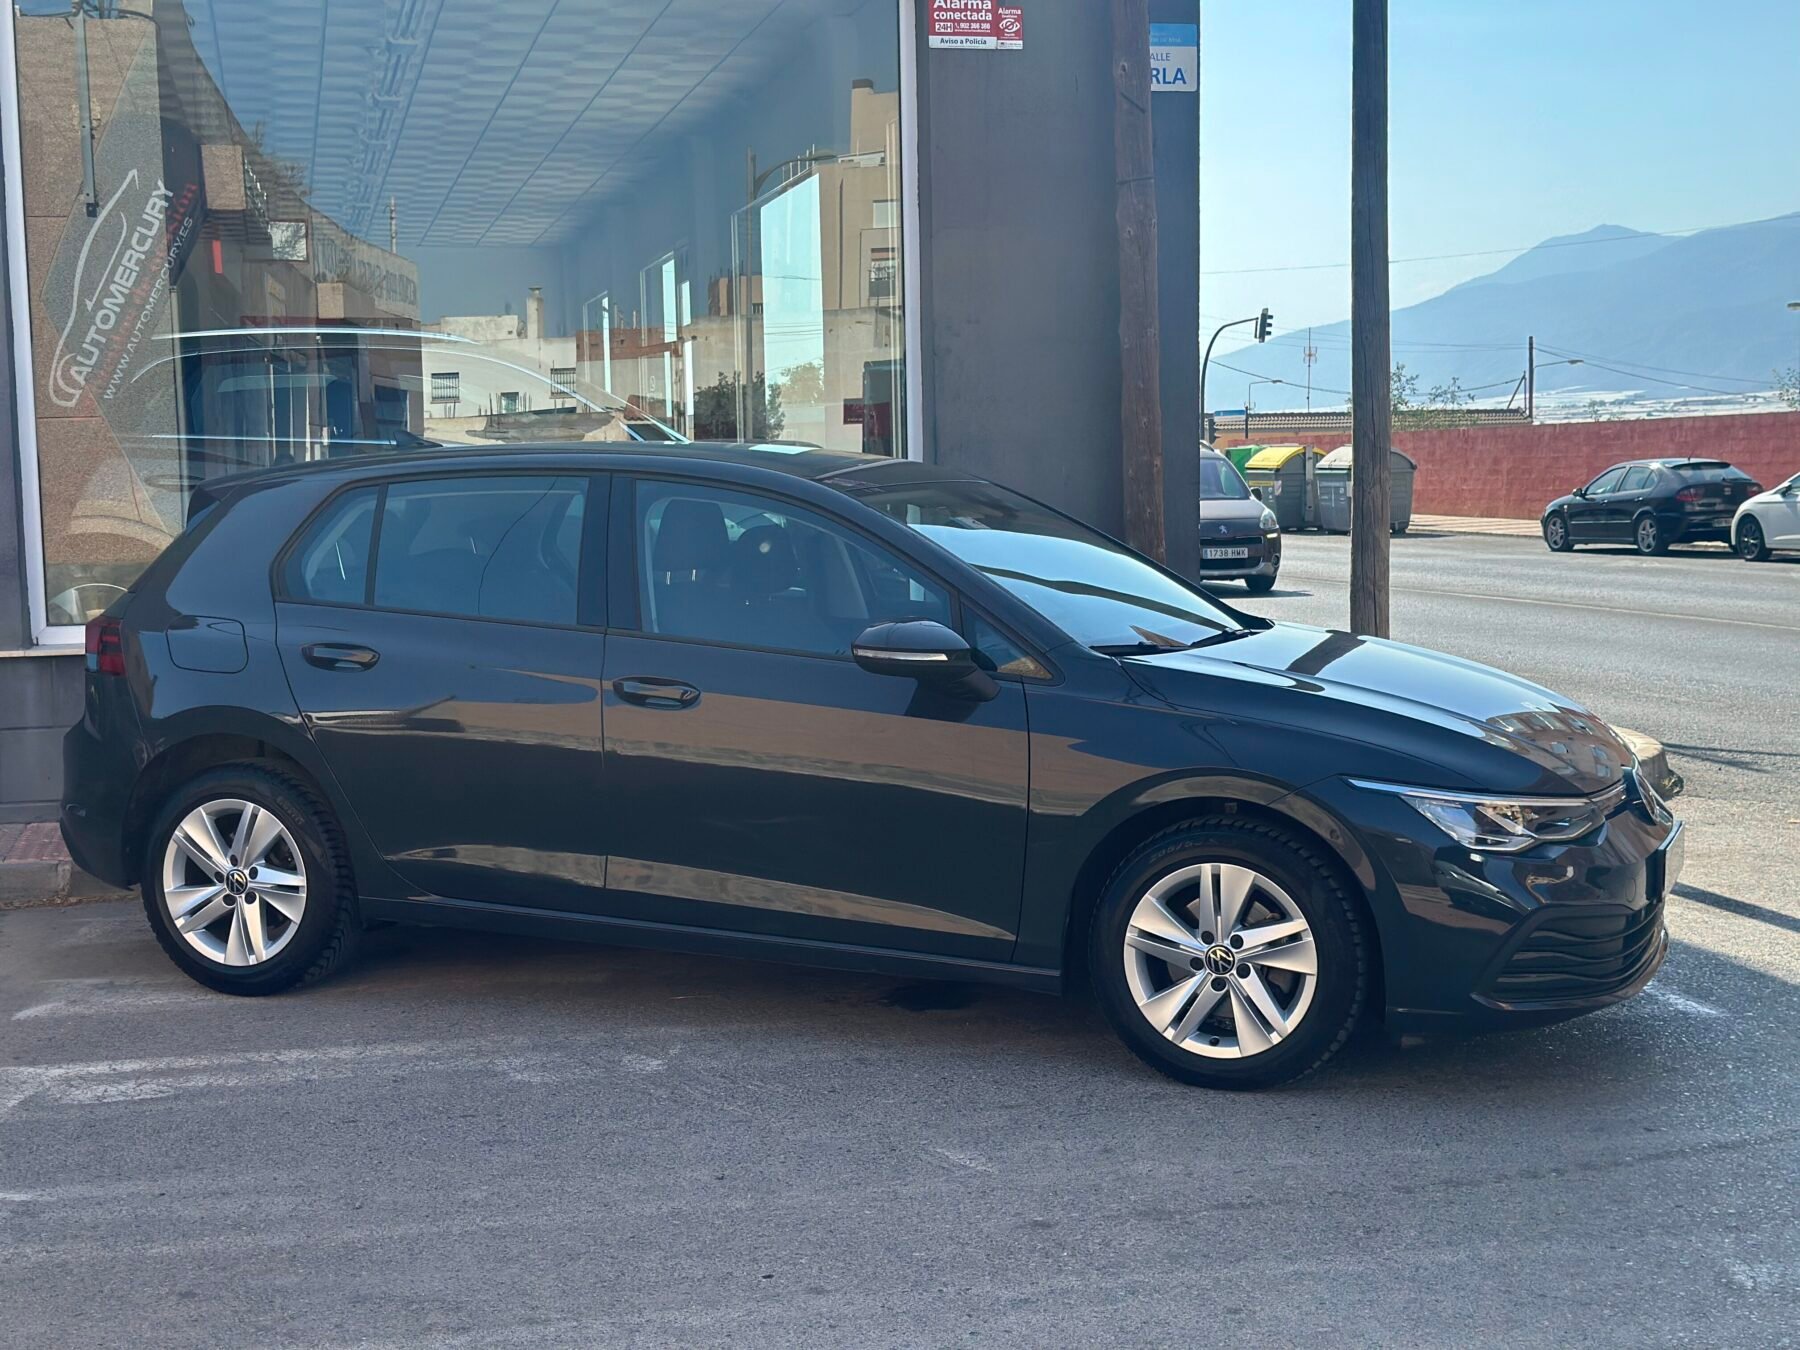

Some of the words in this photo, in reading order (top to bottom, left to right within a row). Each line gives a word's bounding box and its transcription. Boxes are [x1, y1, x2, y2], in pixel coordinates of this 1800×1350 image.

[933, 0, 992, 9] Alarma
[933, 10, 992, 20] conectada
[936, 23, 953, 32] 24H
[1150, 53, 1171, 61] ALLE
[1151, 67, 1187, 85] RLA
[71, 178, 174, 387] AUTOMERCURY
[104, 216, 193, 399] WWW.AUTOMERCURY.ES
[1209, 549, 1229, 557] 1738
